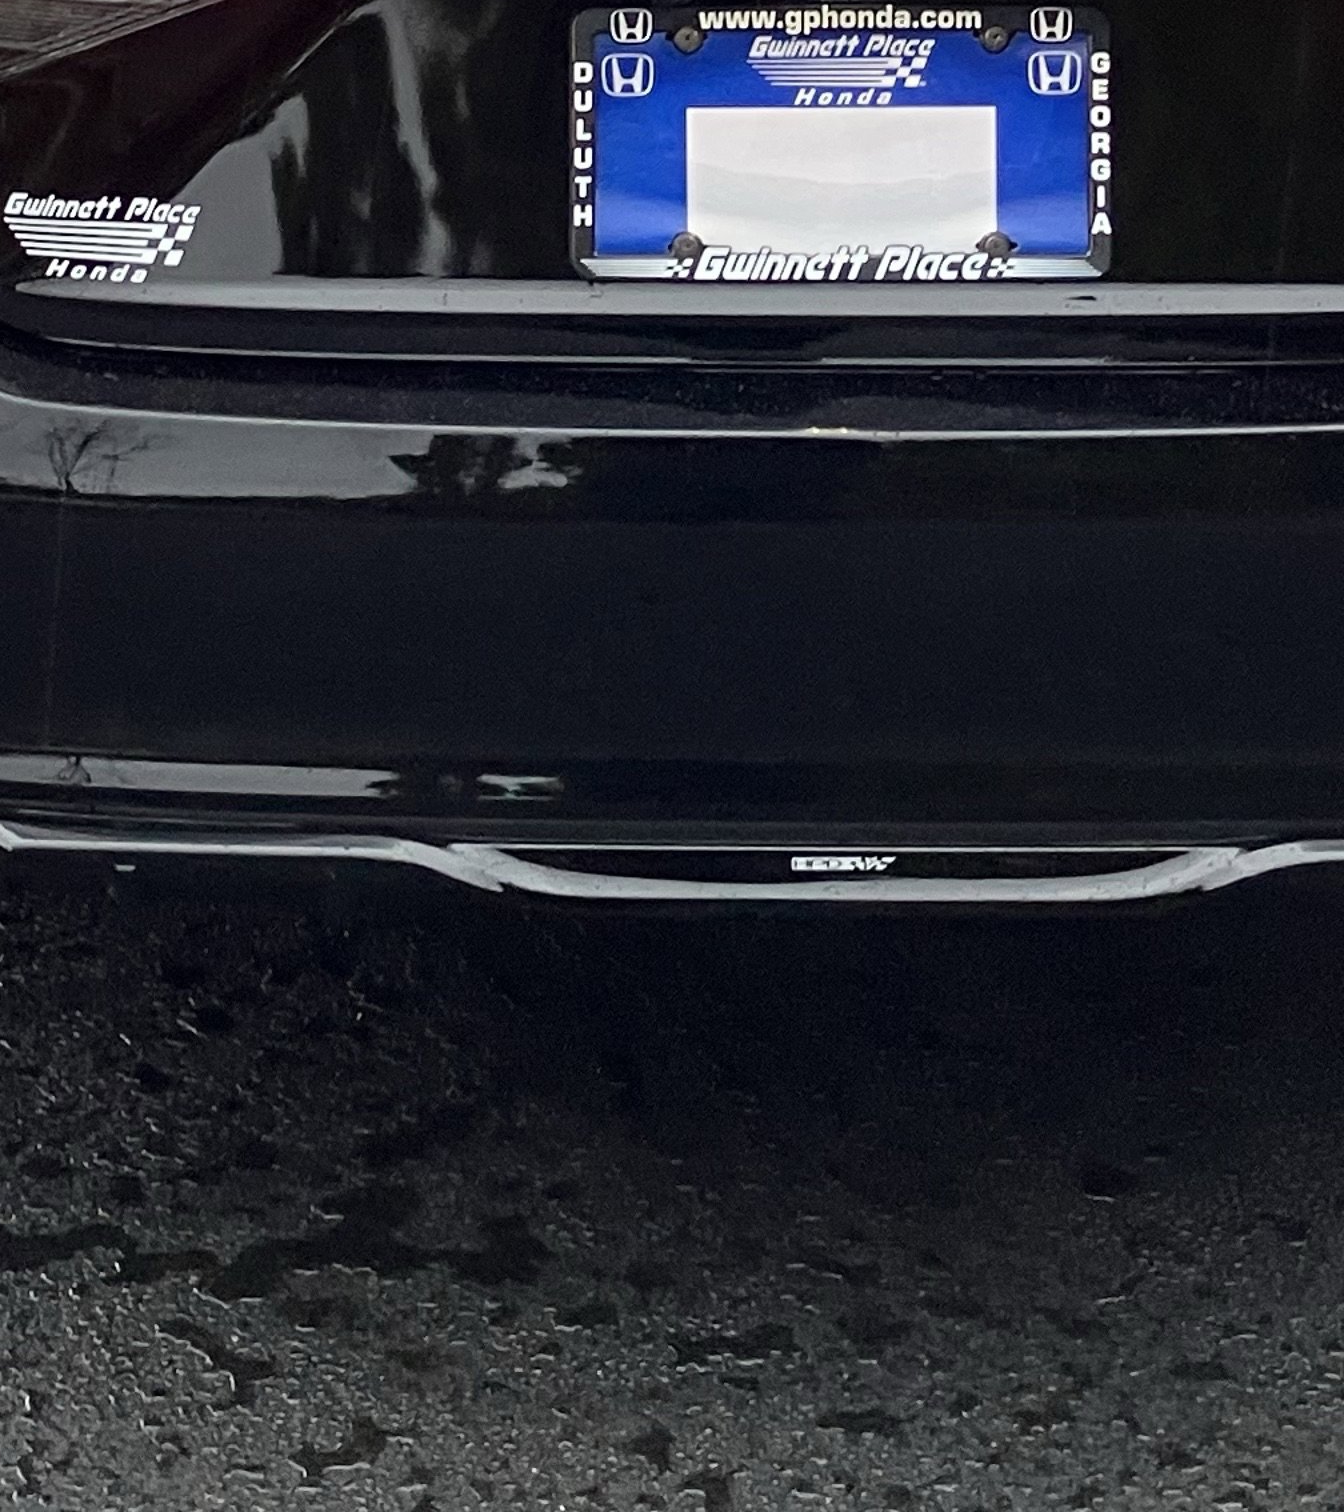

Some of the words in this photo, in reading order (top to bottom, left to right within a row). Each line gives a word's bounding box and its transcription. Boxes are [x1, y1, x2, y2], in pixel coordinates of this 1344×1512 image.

[698, 4, 983, 35] www.gphonda.com
[748, 34, 860, 58] Gwinnett
[863, 35, 936, 57] Place
[793, 88, 893, 106] Honda
[573, 61, 594, 227] DULUTH
[1090, 51, 1112, 235] GEORGIA
[3, 191, 122, 220] Gwinnett
[124, 196, 202, 225] Place
[45, 258, 149, 284] Honda
[693, 245, 869, 281] Gwinnett
[874, 245, 989, 281] Place
